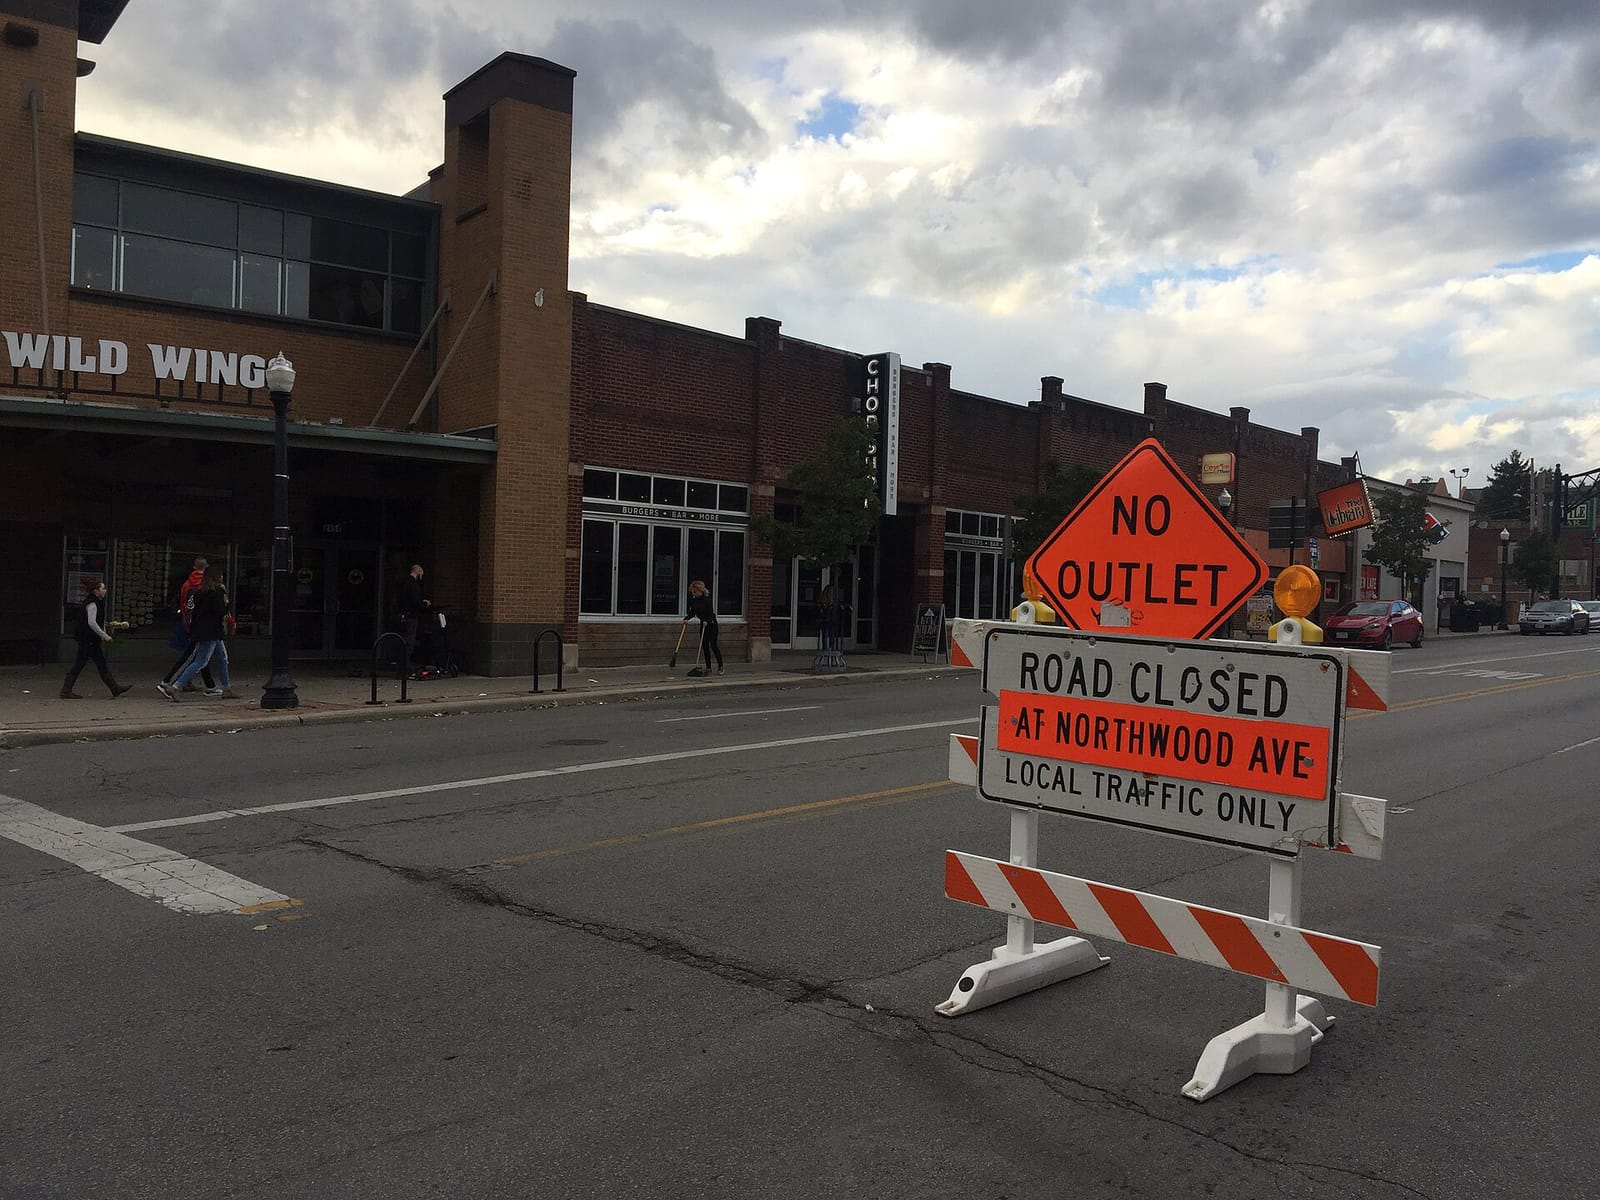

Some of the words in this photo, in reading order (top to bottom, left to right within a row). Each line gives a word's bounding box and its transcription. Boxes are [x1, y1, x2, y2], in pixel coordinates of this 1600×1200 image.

[1, 331, 128, 375] WILD
[146, 343, 293, 389] WING
[622, 506, 659, 517] BURGERS
[671, 511, 687, 519] BAR
[699, 513, 720, 522] MORE
[1112, 494, 1171, 536] NO
[1058, 560, 1228, 606] OUTLET
[1020, 652, 1113, 698] ROAD
[1131, 662, 1288, 718] CLOSED
[1015, 707, 1044, 740] AT
[1056, 711, 1234, 768] NORTHWOOD
[1248, 736, 1311, 779] AVE
[1006, 758, 1082, 796] LOCAL
[1092, 771, 1204, 816] TRAFFIC
[1217, 792, 1296, 832] ONLY
